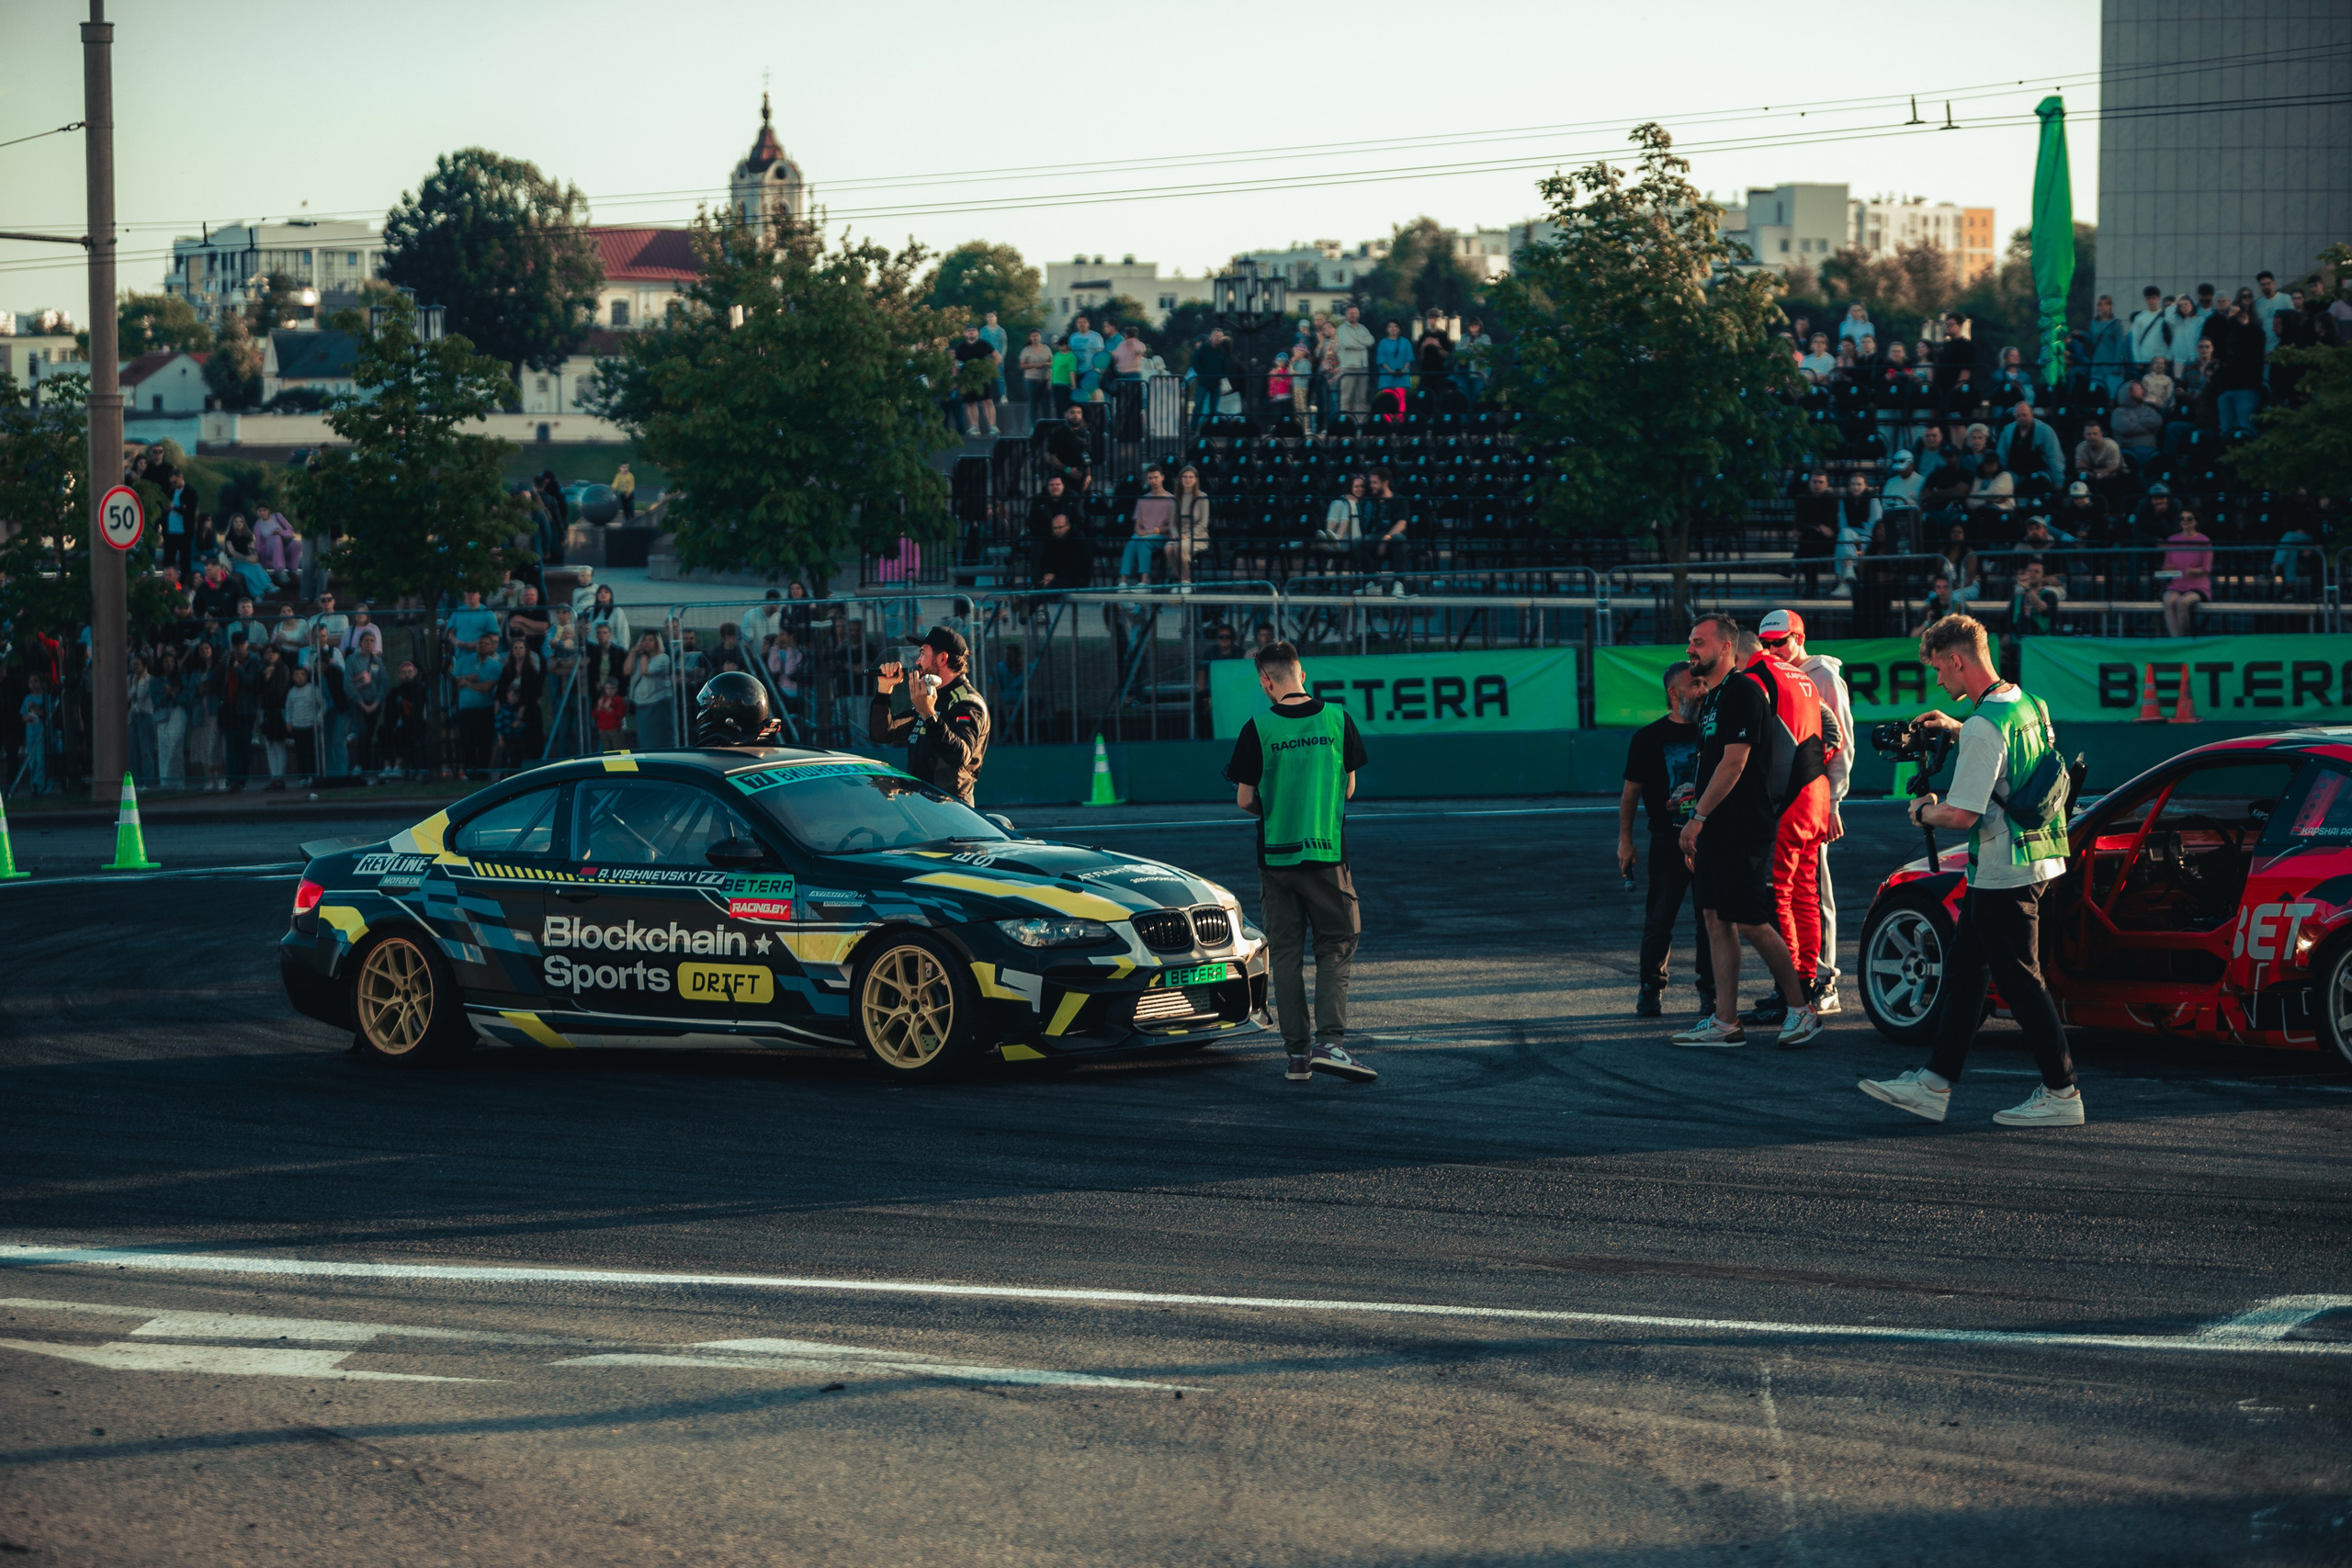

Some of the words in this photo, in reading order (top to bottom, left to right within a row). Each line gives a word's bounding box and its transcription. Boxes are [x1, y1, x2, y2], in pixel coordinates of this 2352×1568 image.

[109, 505, 135, 529] 50
[1798, 682, 1812, 697] 17
[2098, 660, 2352, 708] BET.ER
[1312, 674, 1510, 721] ET.ERA
[1271, 736, 1335, 752] RACINGBY
[743, 773, 768, 786] 77
[2301, 827, 2338, 836] KAPSHAI
[383, 876, 409, 886] MOTOR
[409, 877, 421, 886] OIL
[698, 872, 726, 884] 77
[731, 902, 788, 915] RACING.BY
[543, 916, 747, 956] Blockchain
[543, 954, 671, 994] Sports
[692, 972, 761, 995] DRIFT
